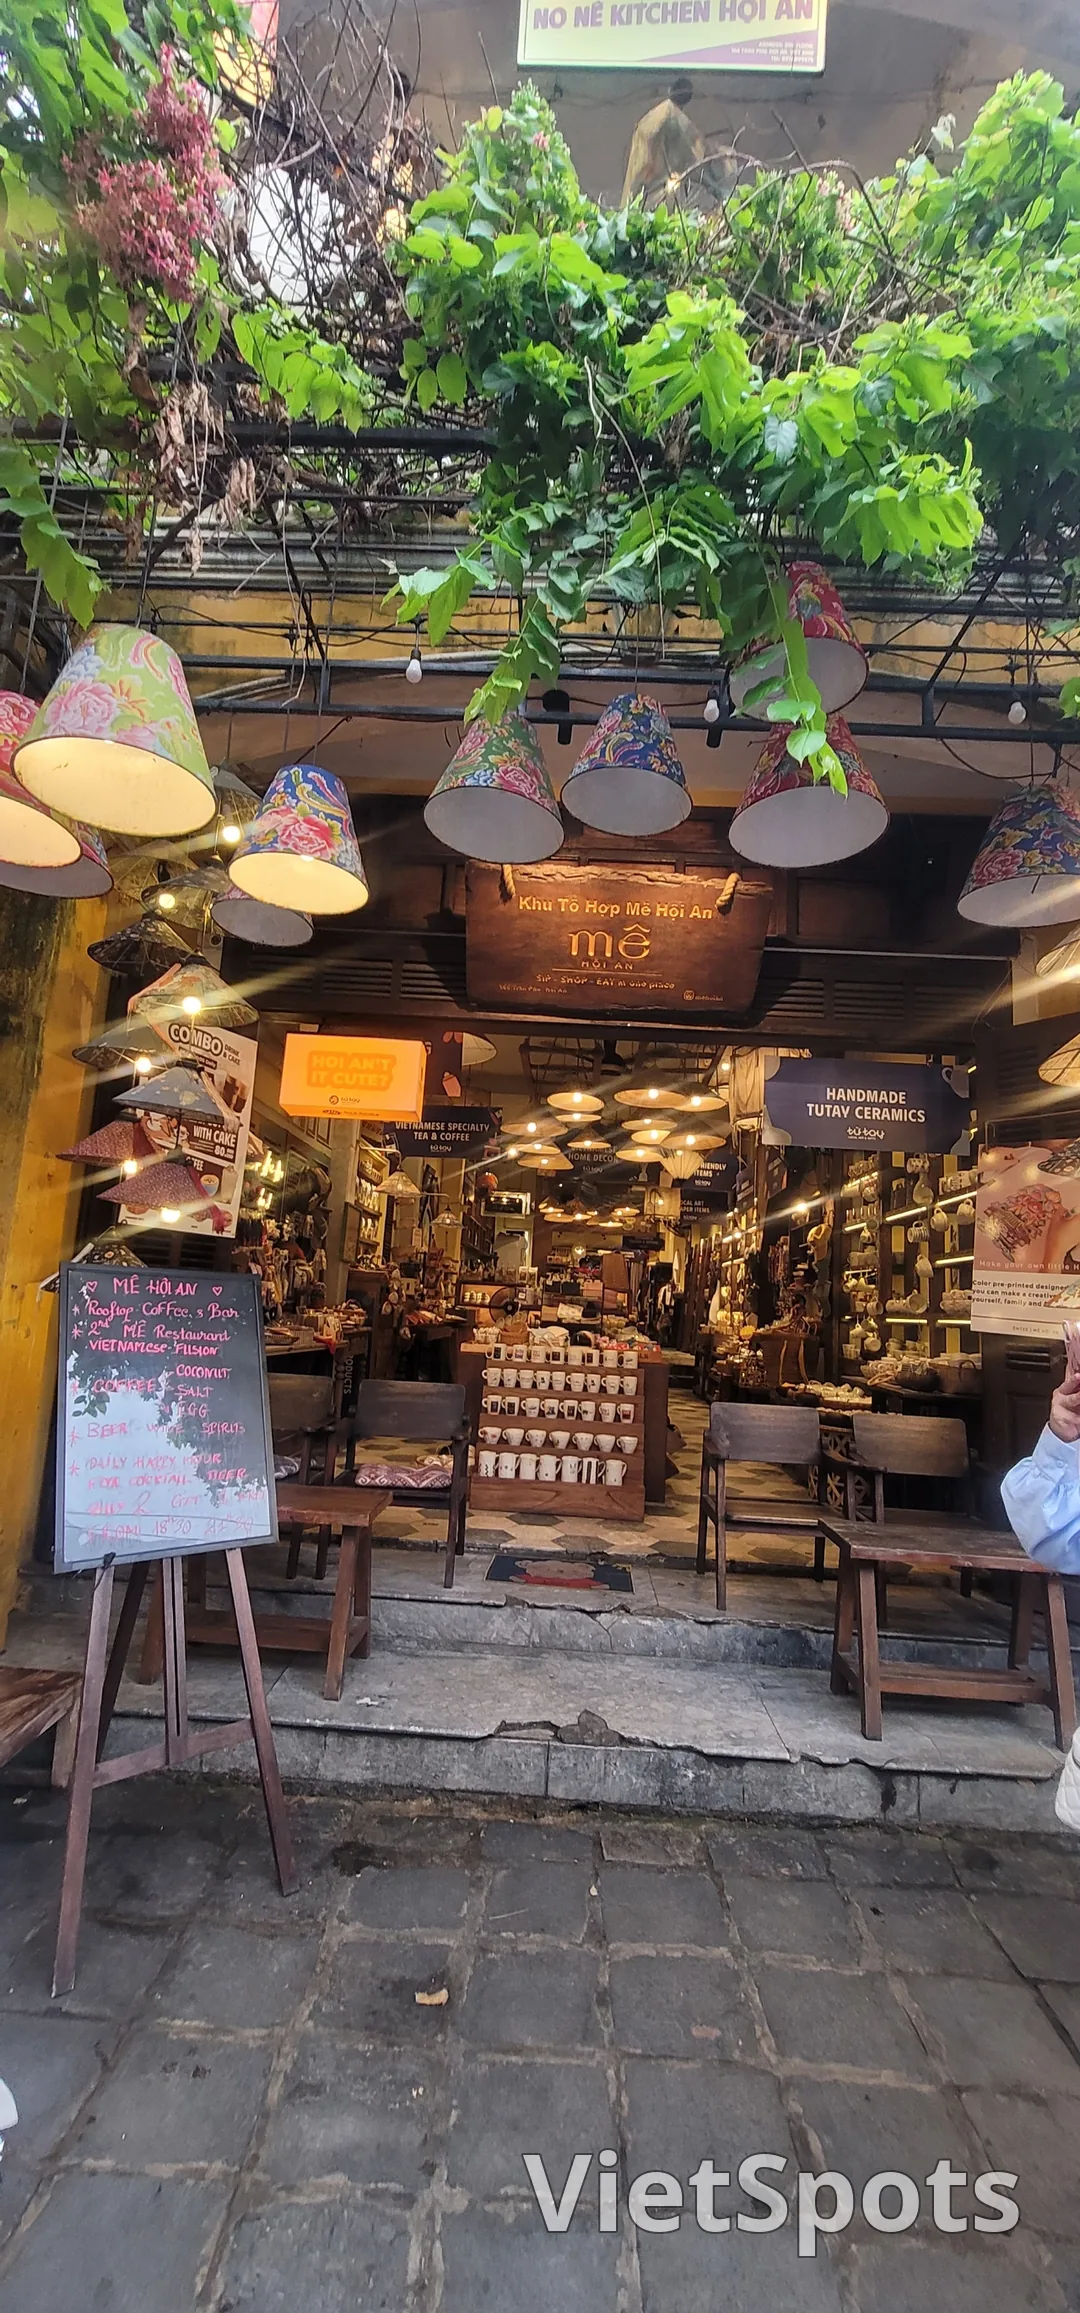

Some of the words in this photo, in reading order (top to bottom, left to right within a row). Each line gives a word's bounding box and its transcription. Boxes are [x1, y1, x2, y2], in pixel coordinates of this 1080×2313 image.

[533, 7, 567, 29] NO
[610, 0, 711, 27] KITCHEN
[775, 0, 813, 20] AN
[519, 896, 553, 912] Khu
[585, 899, 620, 918] Hợp
[625, 901, 651, 916] Mê
[656, 902, 685, 921] Hội
[689, 905, 713, 920] An
[568, 923, 651, 960] mê
[614, 962, 634, 970] AN
[560, 975, 588, 985] SHOP
[168, 1023, 224, 1056] COMBO
[225, 1044, 240, 1057] DRINK
[228, 1055, 241, 1066] CAKE
[312, 1054, 344, 1069] HOI
[312, 1070, 329, 1083] IT
[332, 1072, 388, 1087] CUTE?
[826, 1087, 906, 1104] HANDMADE
[806, 1103, 850, 1118] TUTAY
[855, 1106, 926, 1123] CERAMICS
[395, 1121, 446, 1131] VIETNAMESE
[447, 1123, 490, 1132] SPECIALTY
[193, 1125, 212, 1141] WITH
[213, 1130, 237, 1147] CAKE
[413, 1131, 428, 1140] TEA
[440, 1132, 470, 1141] COFFEE
[568, 1152, 591, 1162] HOME
[700, 1162, 727, 1171] RIENDLY
[980, 1260, 1001, 1268] Make
[1004, 1261, 1023, 1269] your
[1047, 1262, 1069, 1270] little
[113, 1274, 140, 1295] MÊ
[146, 1277, 172, 1296] HỘI
[175, 1282, 198, 1295] AN
[992, 1281, 1034, 1290] pre-printed
[1001, 1289, 1020, 1297] make
[1004, 1298, 1027, 1307] family
[88, 1300, 134, 1323] Rooftop
[207, 1303, 239, 1320] Bar
[123, 1319, 147, 1338] MÊ
[176, 1364, 232, 1380] COCONUT
[93, 1378, 157, 1393] COFFEE
[174, 1383, 214, 1398] SALT
[177, 1399, 209, 1417] EGG
[87, 1422, 127, 1439] BEER
[133, 1455, 177, 1471] HAPPY
